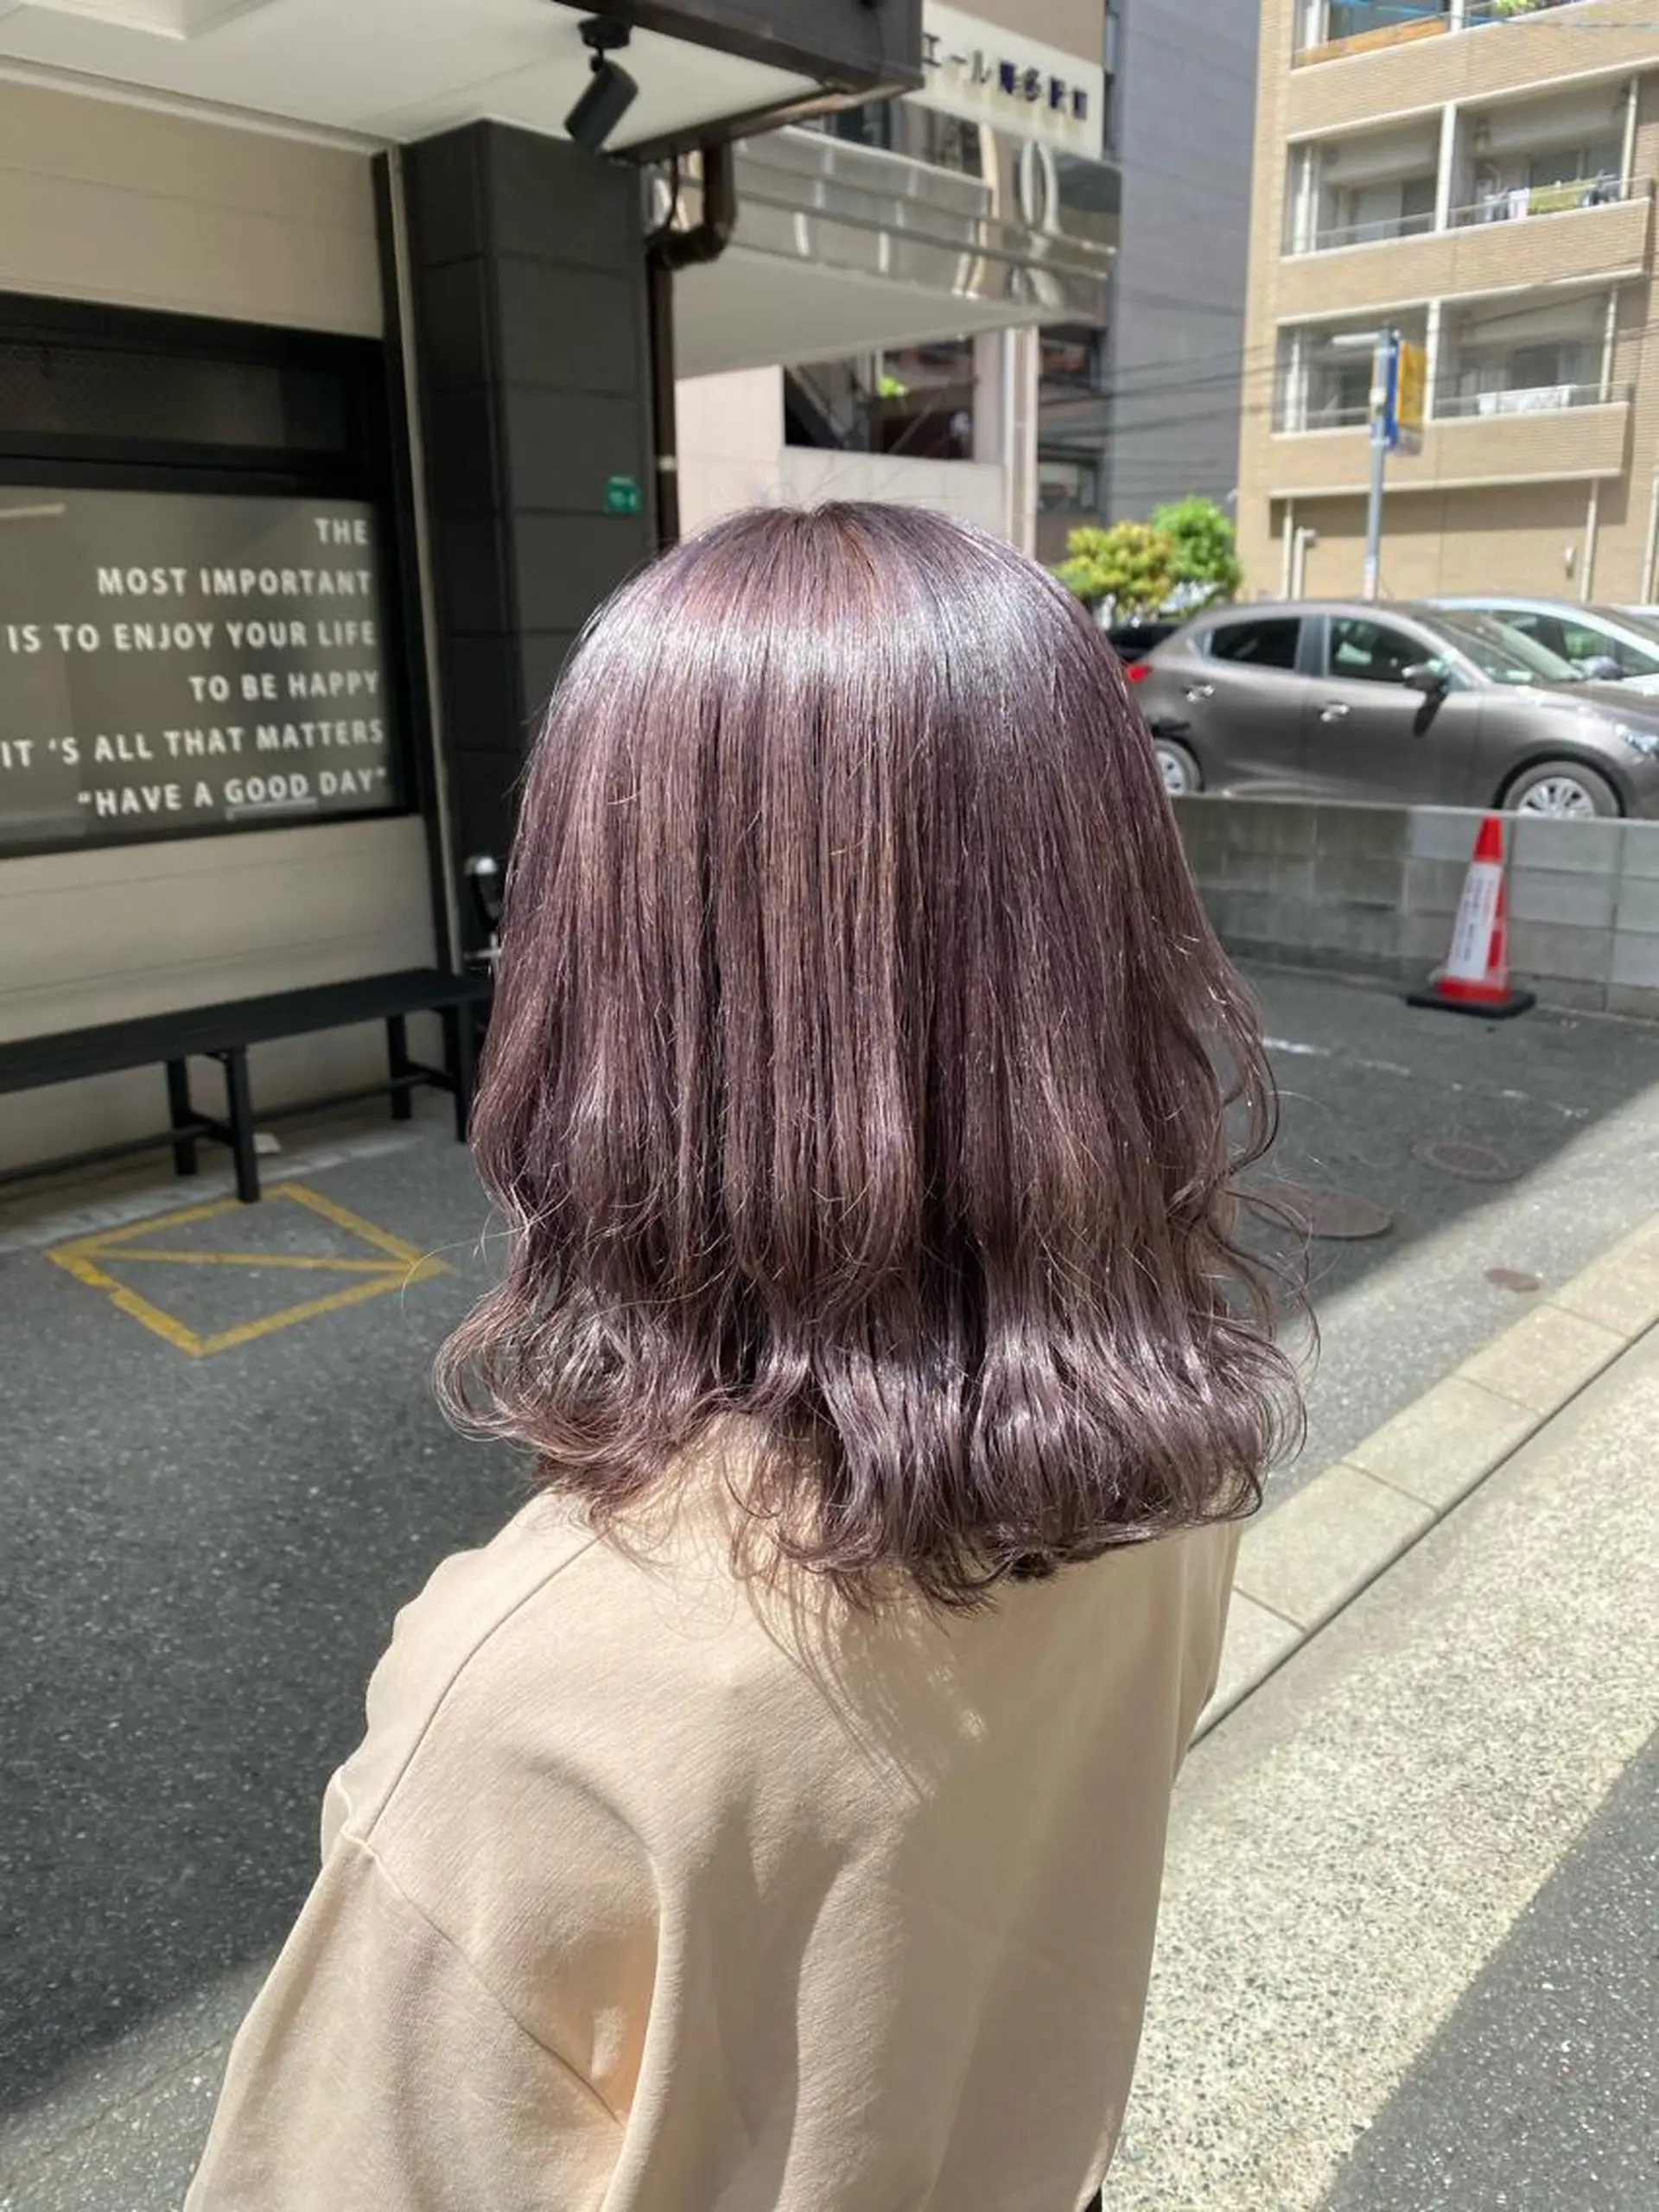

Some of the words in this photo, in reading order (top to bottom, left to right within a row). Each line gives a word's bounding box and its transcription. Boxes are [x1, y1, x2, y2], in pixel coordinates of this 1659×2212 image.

[315, 518, 369, 544] THE
[97, 567, 188, 595] MOST
[200, 568, 371, 596] IMPORTANT
[6, 624, 41, 653] IS
[54, 623, 100, 652] TO
[113, 622, 214, 652] ENJOY
[226, 620, 308, 649] YOUR
[318, 620, 375, 646] LIFE
[188, 674, 230, 702] TO
[240, 672, 277, 702] BE
[288, 671, 378, 697] HAPPY
[94, 733, 153, 762] ALL
[163, 726, 245, 757] THAT
[256, 719, 384, 750] MATTERS
[194, 781, 214, 808] A
[224, 772, 309, 804] GOOD
